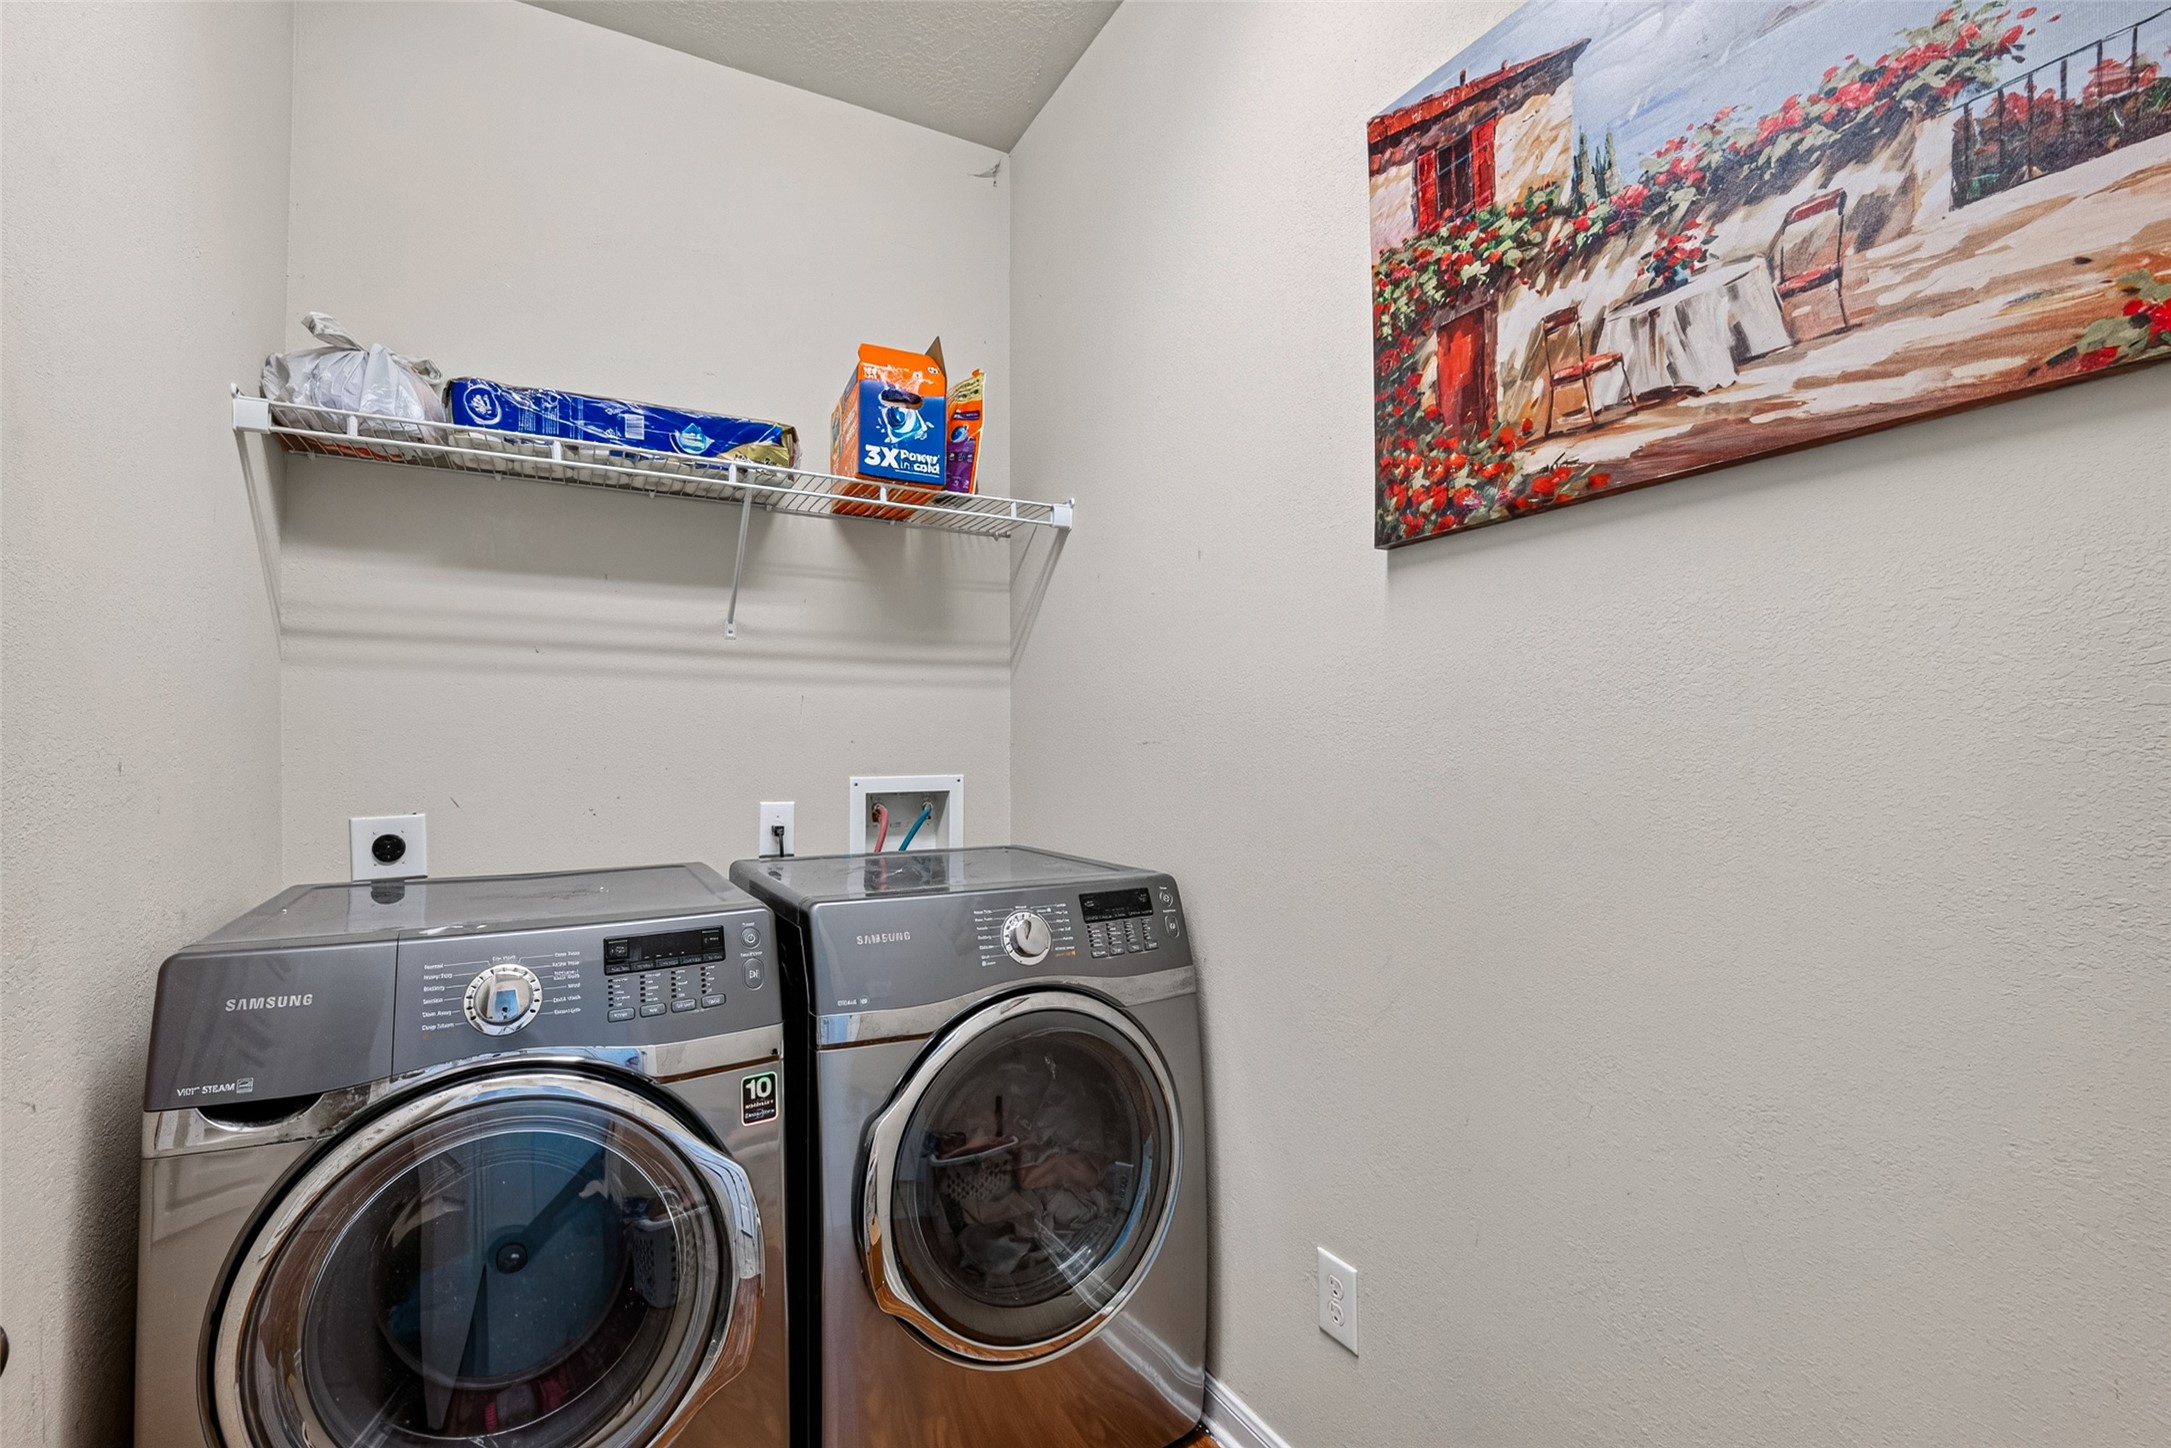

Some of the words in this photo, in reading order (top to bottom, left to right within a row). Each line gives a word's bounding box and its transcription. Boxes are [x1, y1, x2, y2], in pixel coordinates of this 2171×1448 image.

[864, 444, 900, 469] 3X
[900, 449, 938, 464] Power
[900, 460, 910, 470] in
[913, 463, 940, 475] cold
[856, 931, 911, 945] SAMSUNG
[225, 993, 313, 1012] SAMSUNG
[202, 1082, 235, 1094] STEAM
[745, 1076, 772, 1099] 10
